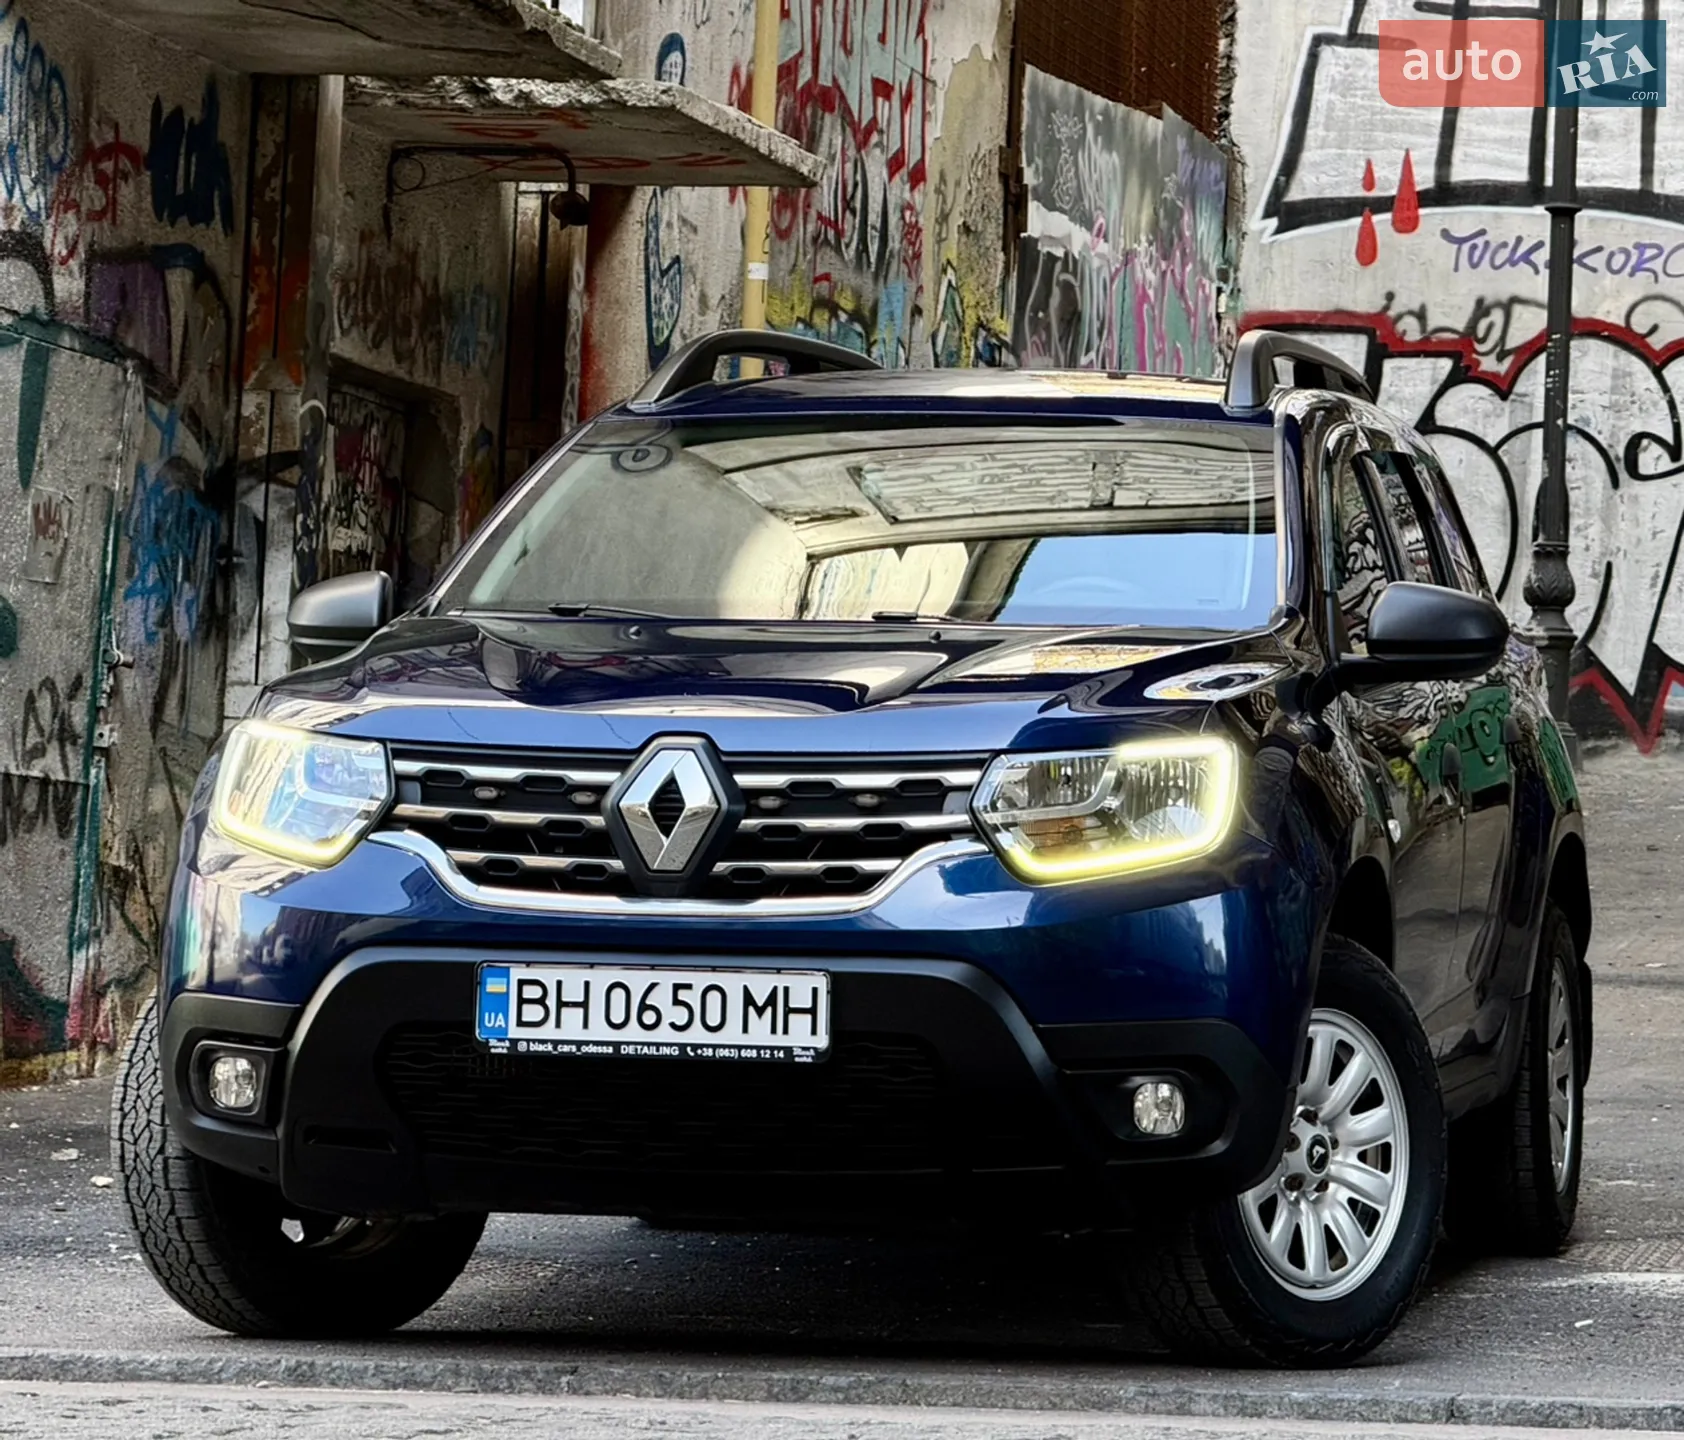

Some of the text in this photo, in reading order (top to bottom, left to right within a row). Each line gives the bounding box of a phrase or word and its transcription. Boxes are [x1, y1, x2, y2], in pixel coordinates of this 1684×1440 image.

[516, 977, 819, 1037] BH 0650 MH
[484, 1012, 507, 1029] UA
[529, 1041, 614, 1056] black_cars_odessa
[620, 1044, 680, 1057] DETAILING
[696, 1047, 714, 1058] +38
[760, 1049, 771, 1059] 12
[773, 1049, 785, 1059] 14
